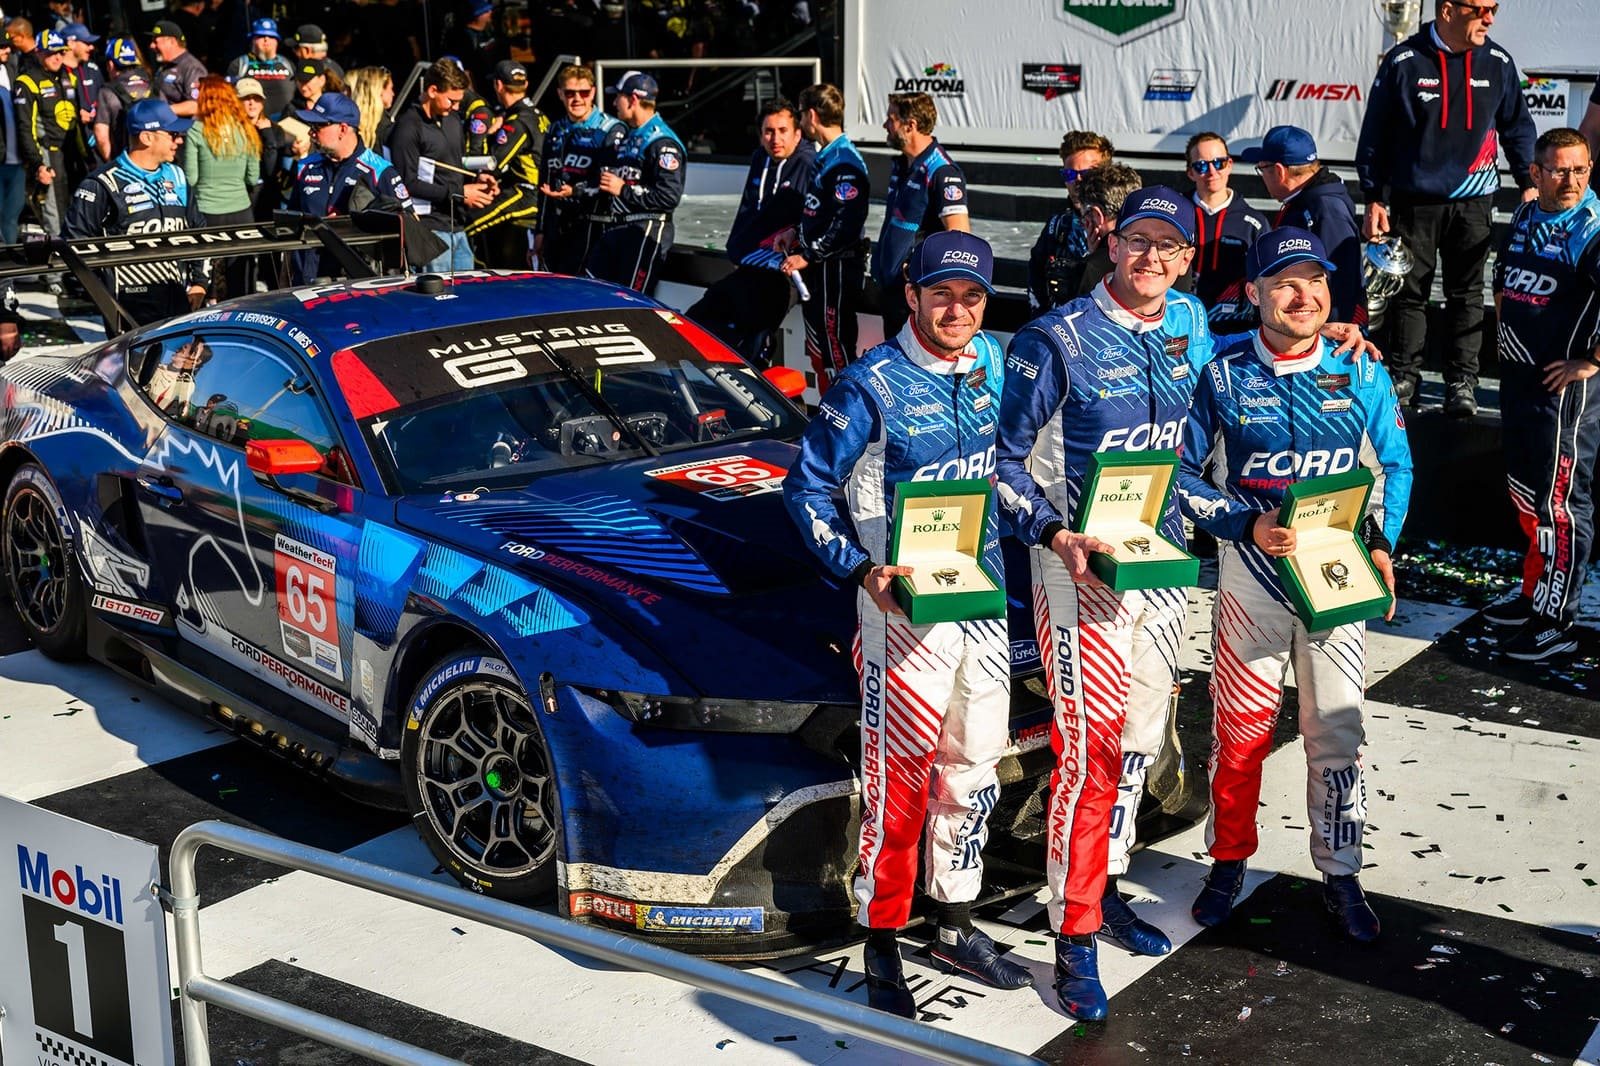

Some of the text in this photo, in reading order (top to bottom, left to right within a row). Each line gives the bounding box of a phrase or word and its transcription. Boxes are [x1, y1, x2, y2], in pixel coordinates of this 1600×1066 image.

[894, 78, 965, 92] DAYTONA
[1296, 83, 1362, 101] IMSA
[1418, 78, 1440, 86] FORD
[1140, 198, 1178, 212] FORD
[126, 217, 185, 236] FORD
[70, 229, 264, 255] USTANG
[1279, 239, 1312, 250] FORD
[943, 250, 979, 263] FORD
[242, 312, 278, 327] VERVISCH
[427, 323, 632, 359] MUSTANG
[1053, 324, 1079, 357] sparco
[443, 335, 656, 389] GT3
[1007, 356, 1038, 380] GT3
[1208, 361, 1226, 393] sparco
[868, 376, 894, 408] sparco
[685, 463, 772, 486] 65
[911, 444, 997, 483] FORD
[1241, 448, 1354, 478] FORD
[1100, 491, 1143, 502] ROLEX
[1298, 503, 1341, 520] ROLEX
[913, 522, 961, 533] ROLEX
[276, 536, 335, 570] WeatherTech
[286, 564, 328, 633] 65
[105, 601, 163, 621] GTD PRO
[1010, 643, 1040, 662] Ford
[485, 662, 506, 673] PILOT
[420, 660, 475, 706] MICHELIN
[17, 843, 124, 925] Mobil
[574, 896, 634, 920] MOTUL
[670, 915, 752, 927] MICHELIN
[53, 920, 94, 1039] 1
